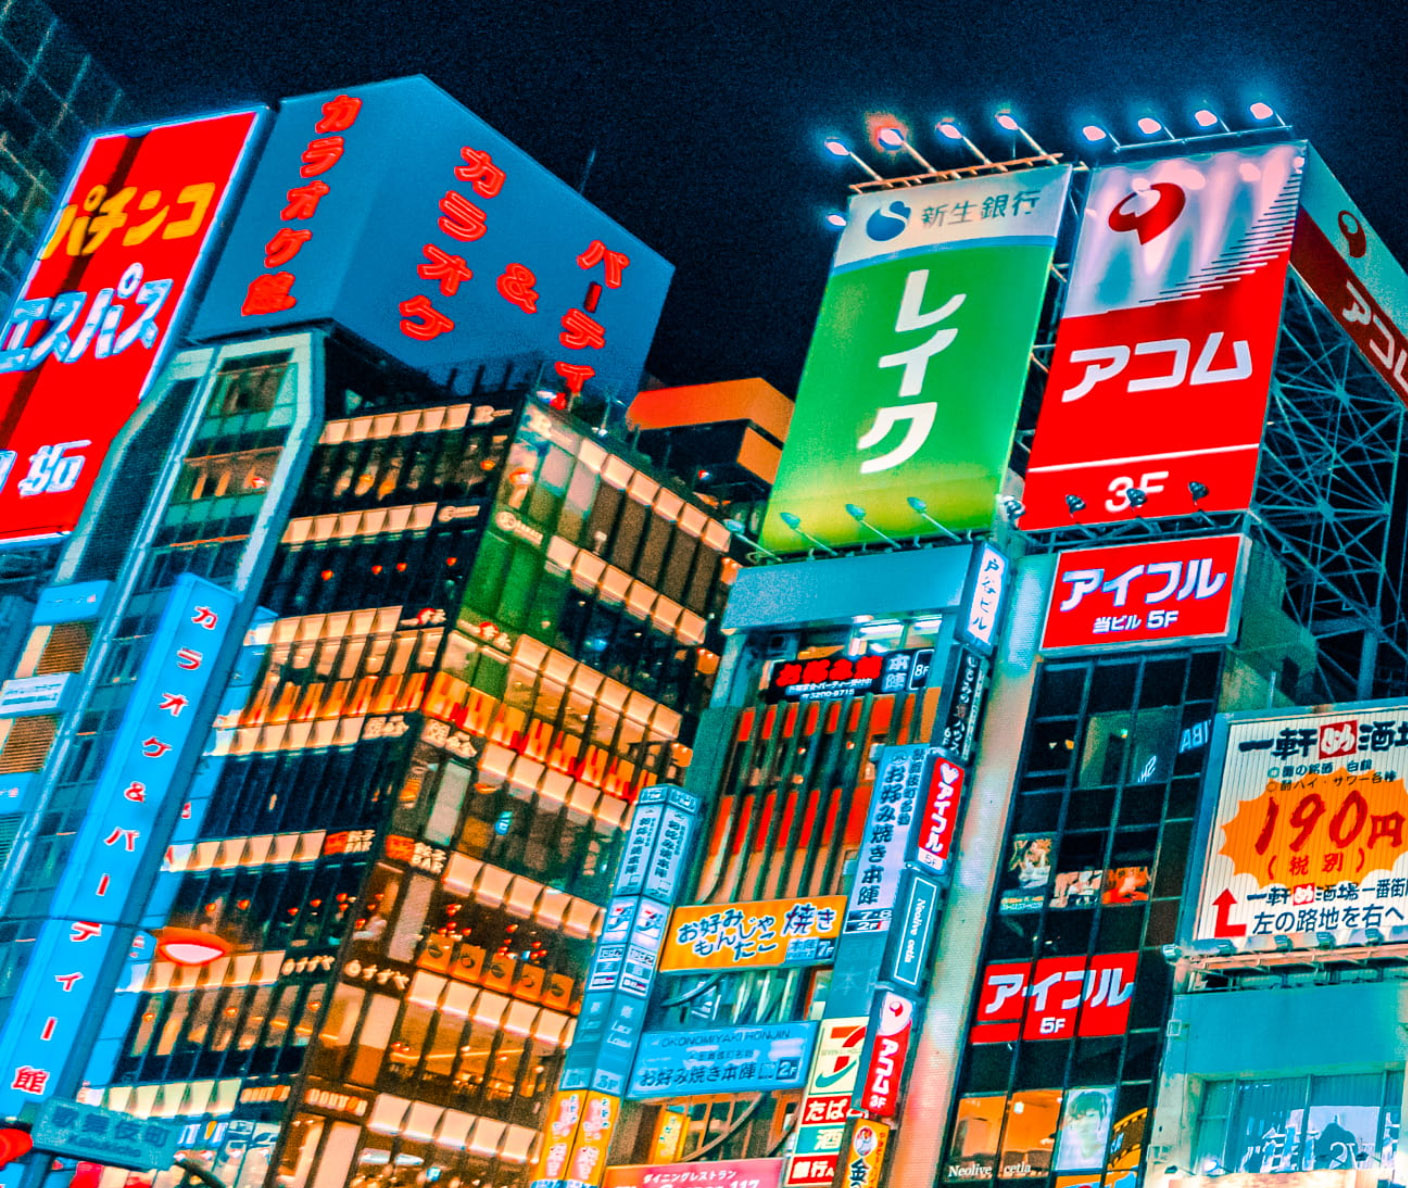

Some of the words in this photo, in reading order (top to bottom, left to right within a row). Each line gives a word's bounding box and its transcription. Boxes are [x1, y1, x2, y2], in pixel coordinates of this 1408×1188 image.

[41, 183, 216, 260] パチンコ
[920, 187, 1041, 228] 新生銀行
[399, 146, 506, 340] カラオケ
[496, 262, 539, 313] &
[0, 262, 174, 372] エスパス
[857, 268, 967, 475] レイク
[1061, 331, 1253, 403] アコム
[1104, 471, 1169, 513] 3F
[1059, 556, 1227, 612] アイフル
[1091, 613, 1141, 634] 当ビル
[1146, 609, 1178, 629] 5F
[858, 766, 906, 906] お好み焼き本陣
[925, 782, 954, 854] アイフル
[1255, 790, 1406, 856] 190円
[1252, 903, 1404, 935] 左の路地を右へ
[986, 967, 1135, 1014] アイフル
[1040, 1016, 1066, 1034] 5F
[640, 1063, 756, 1087] お好み焼き本陣
[874, 1038, 901, 1095] アコム
[948, 1163, 993, 1178] Neolive
